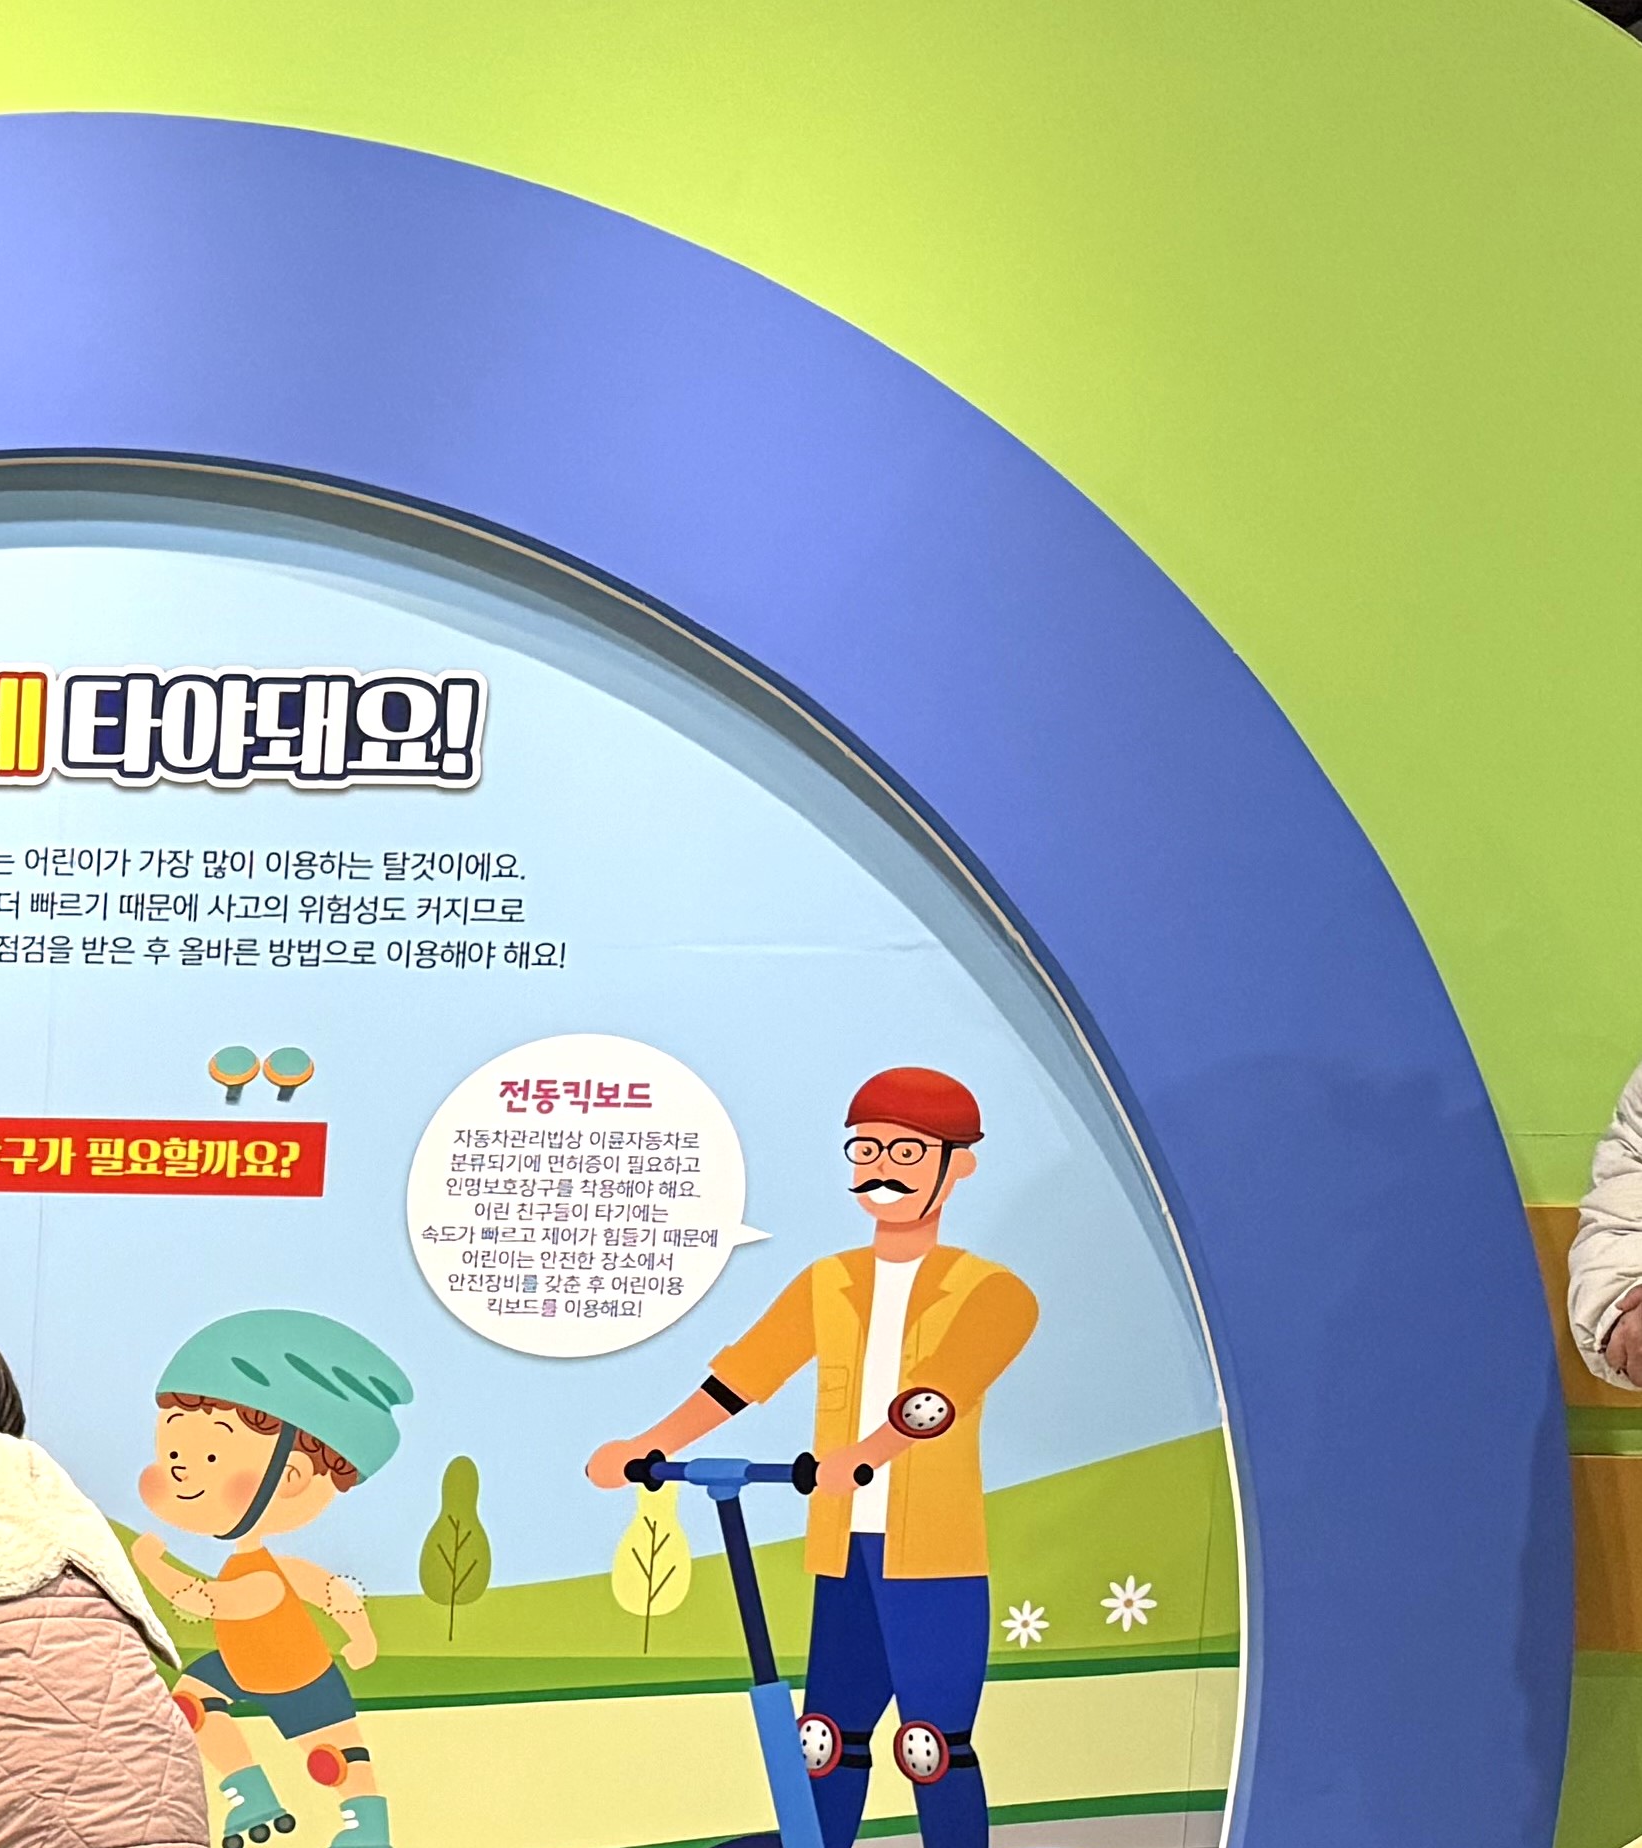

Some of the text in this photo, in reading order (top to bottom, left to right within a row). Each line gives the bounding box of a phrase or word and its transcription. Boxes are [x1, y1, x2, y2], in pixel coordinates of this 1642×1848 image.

[66, 676, 478, 776] 타야돼요!
[25, 847, 132, 878] 어린이가
[139, 848, 194, 879] 가장
[203, 849, 254, 880] 많이
[265, 850, 374, 881] 이용하는
[383, 851, 525, 882] 탈것이에요.
[30, 891, 108, 921] 빠르기
[119, 892, 199, 923] 때문에
[207, 893, 288, 924] 사고의
[298, 894, 407, 925] 위험성도
[416, 896, 525, 926] 커지므로
[82, 936, 135, 965] 받은
[143, 936, 170, 966] 후
[178, 936, 261, 967] 올바른
[269, 938, 377, 968] 방법으로
[387, 939, 497, 970] 이용해야
[503, 941, 566, 970] 해요!
[498, 1079, 653, 1115] 전동킥보드
[453, 1128, 700, 1151] 자동차관리법상 이륜자동차로
[86, 1137, 301, 1178] 필요할까요?
[450, 1153, 542, 1173] 분류되기에
[627, 1155, 701, 1176] 필요하고
[579, 1178, 655, 1199] 착용해야
[474, 1201, 669, 1224] 어린 친구들이 타기에는
[420, 1224, 719, 1248] 속도가 빠르고 제어가 힘들기 때문에
[461, 1249, 674, 1272] 어린이는 안전한 장소에서
[544, 1273, 581, 1294] 갖춘
[586, 1275, 605, 1295] 후
[611, 1275, 685, 1296] 어린이용
[487, 1297, 643, 1319] 킥보드를 이용해요!
